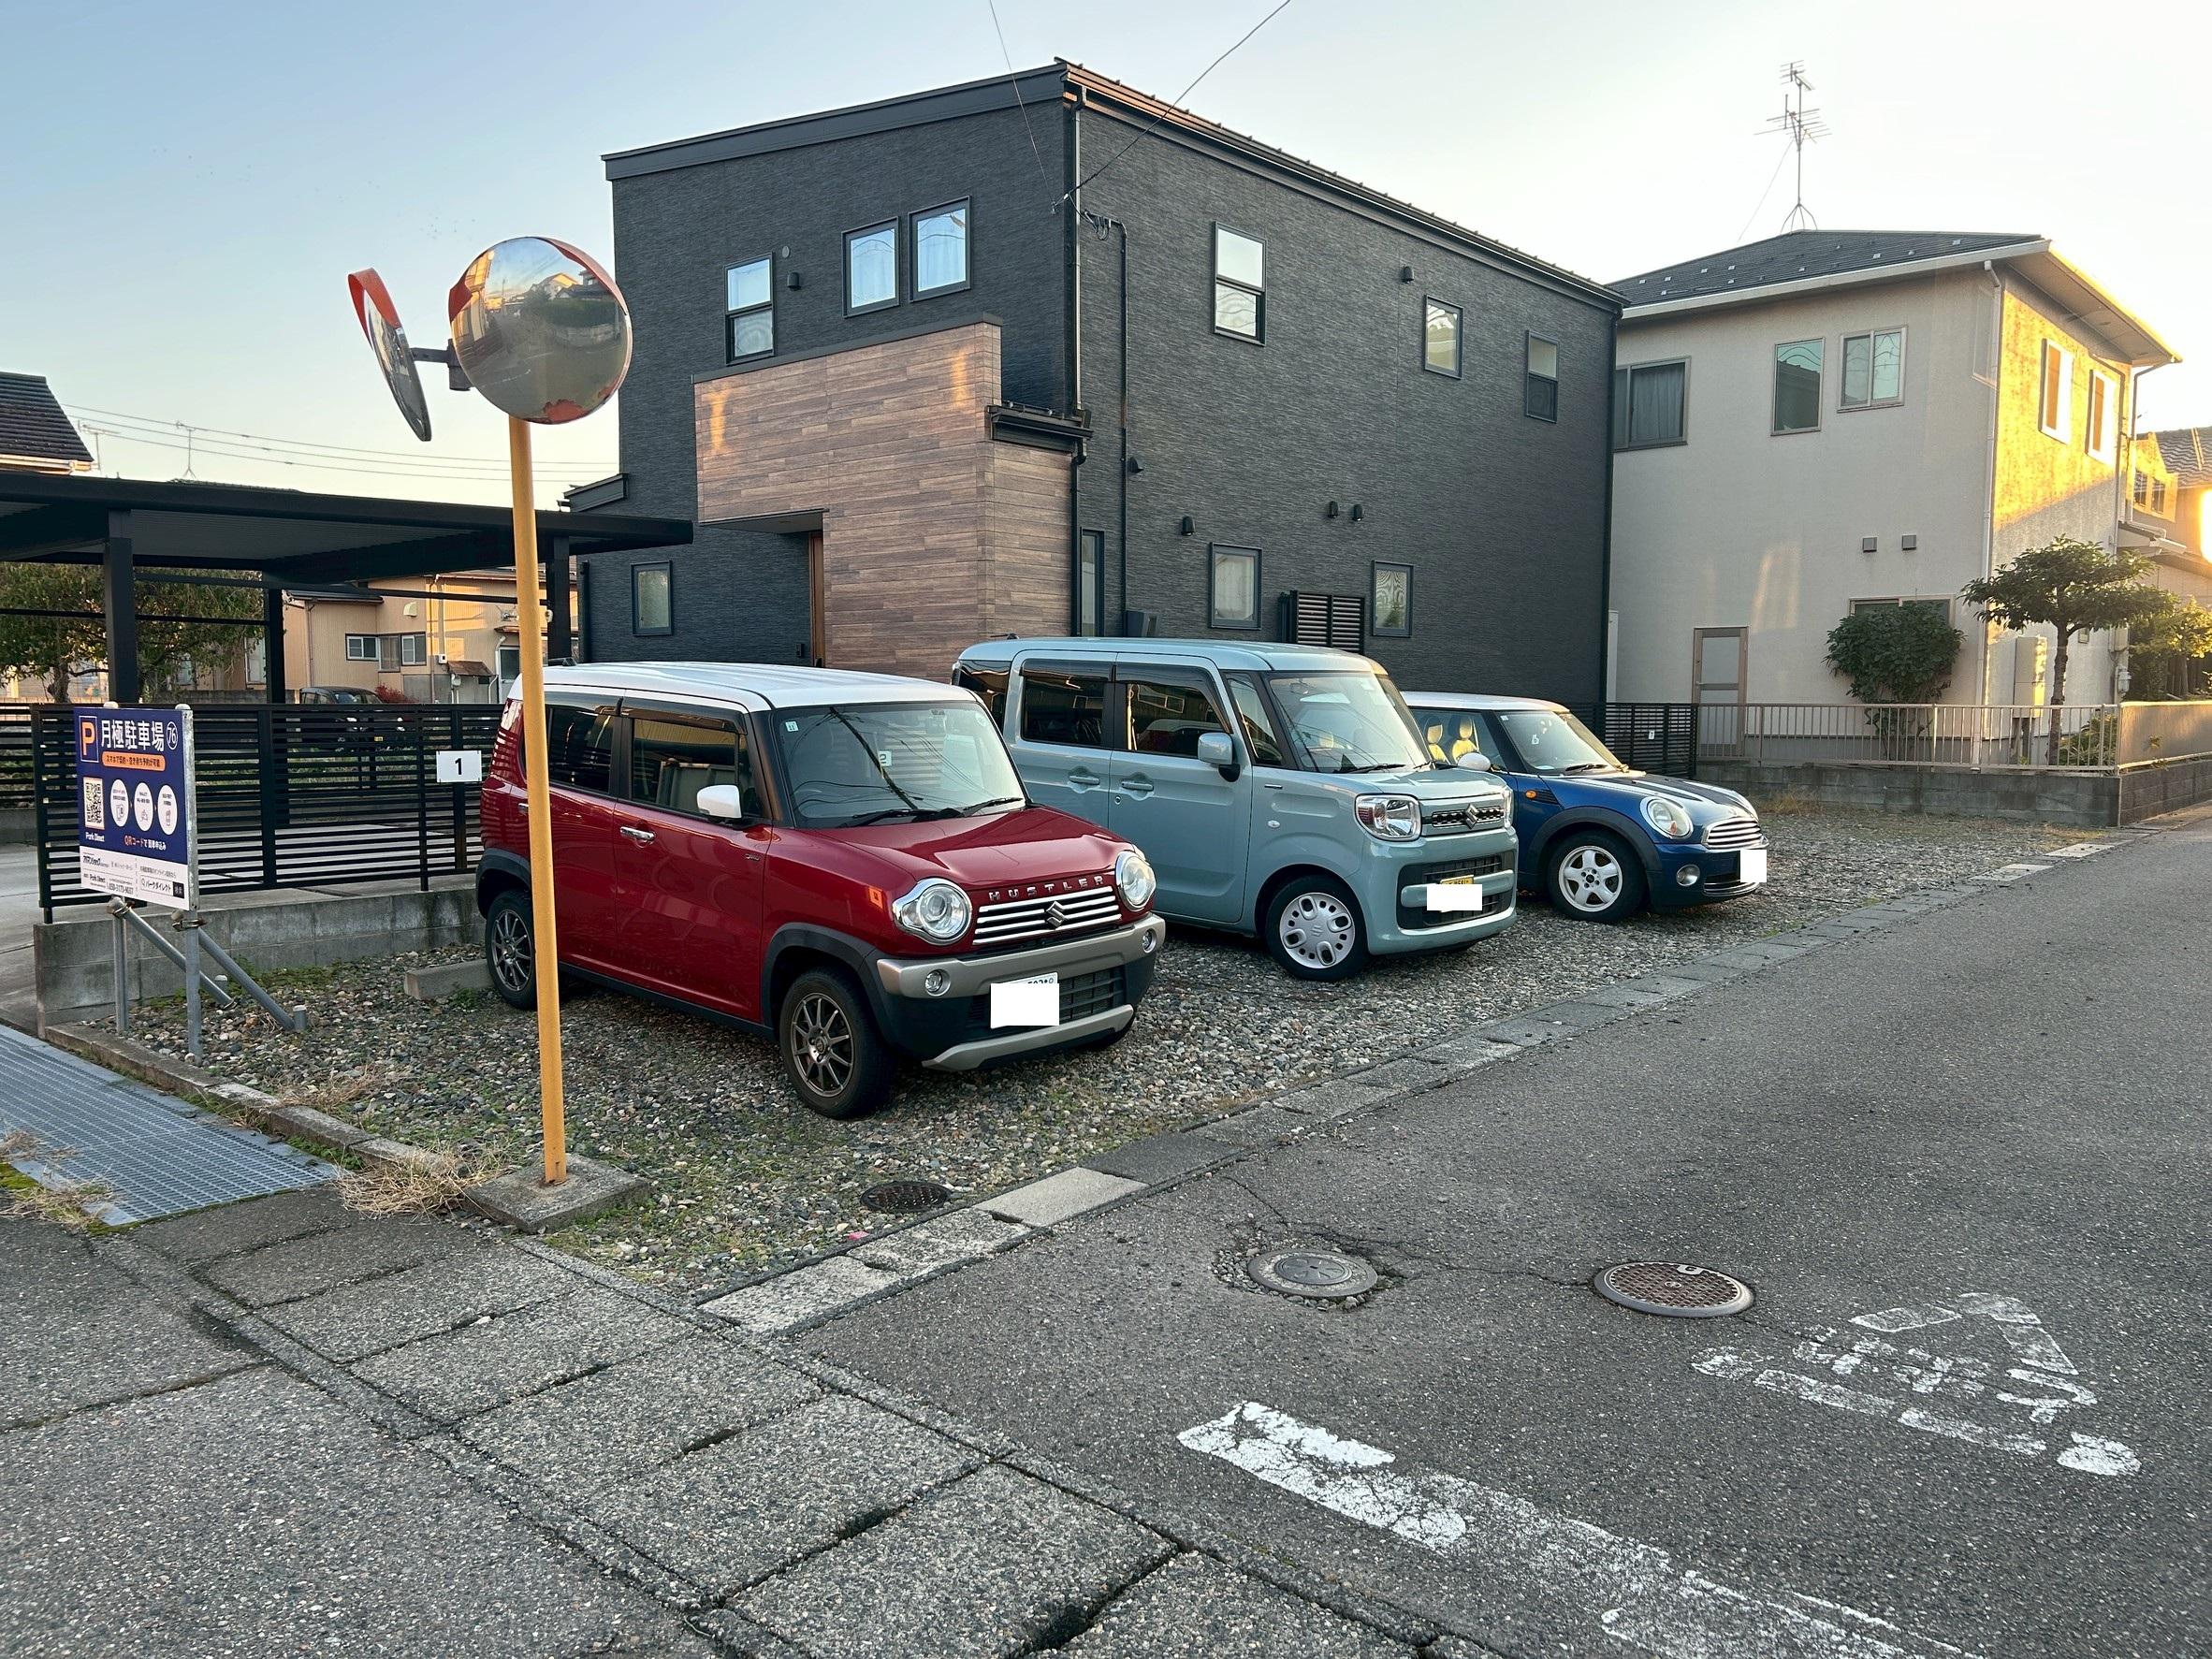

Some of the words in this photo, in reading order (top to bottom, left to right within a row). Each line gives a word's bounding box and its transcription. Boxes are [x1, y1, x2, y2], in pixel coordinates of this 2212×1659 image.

[81, 721, 95, 756] P
[101, 720, 165, 752] 月極駐車場
[167, 725, 178, 746] 76
[455, 757, 462, 775] 1
[988, 875, 1104, 901] HUSTLER
